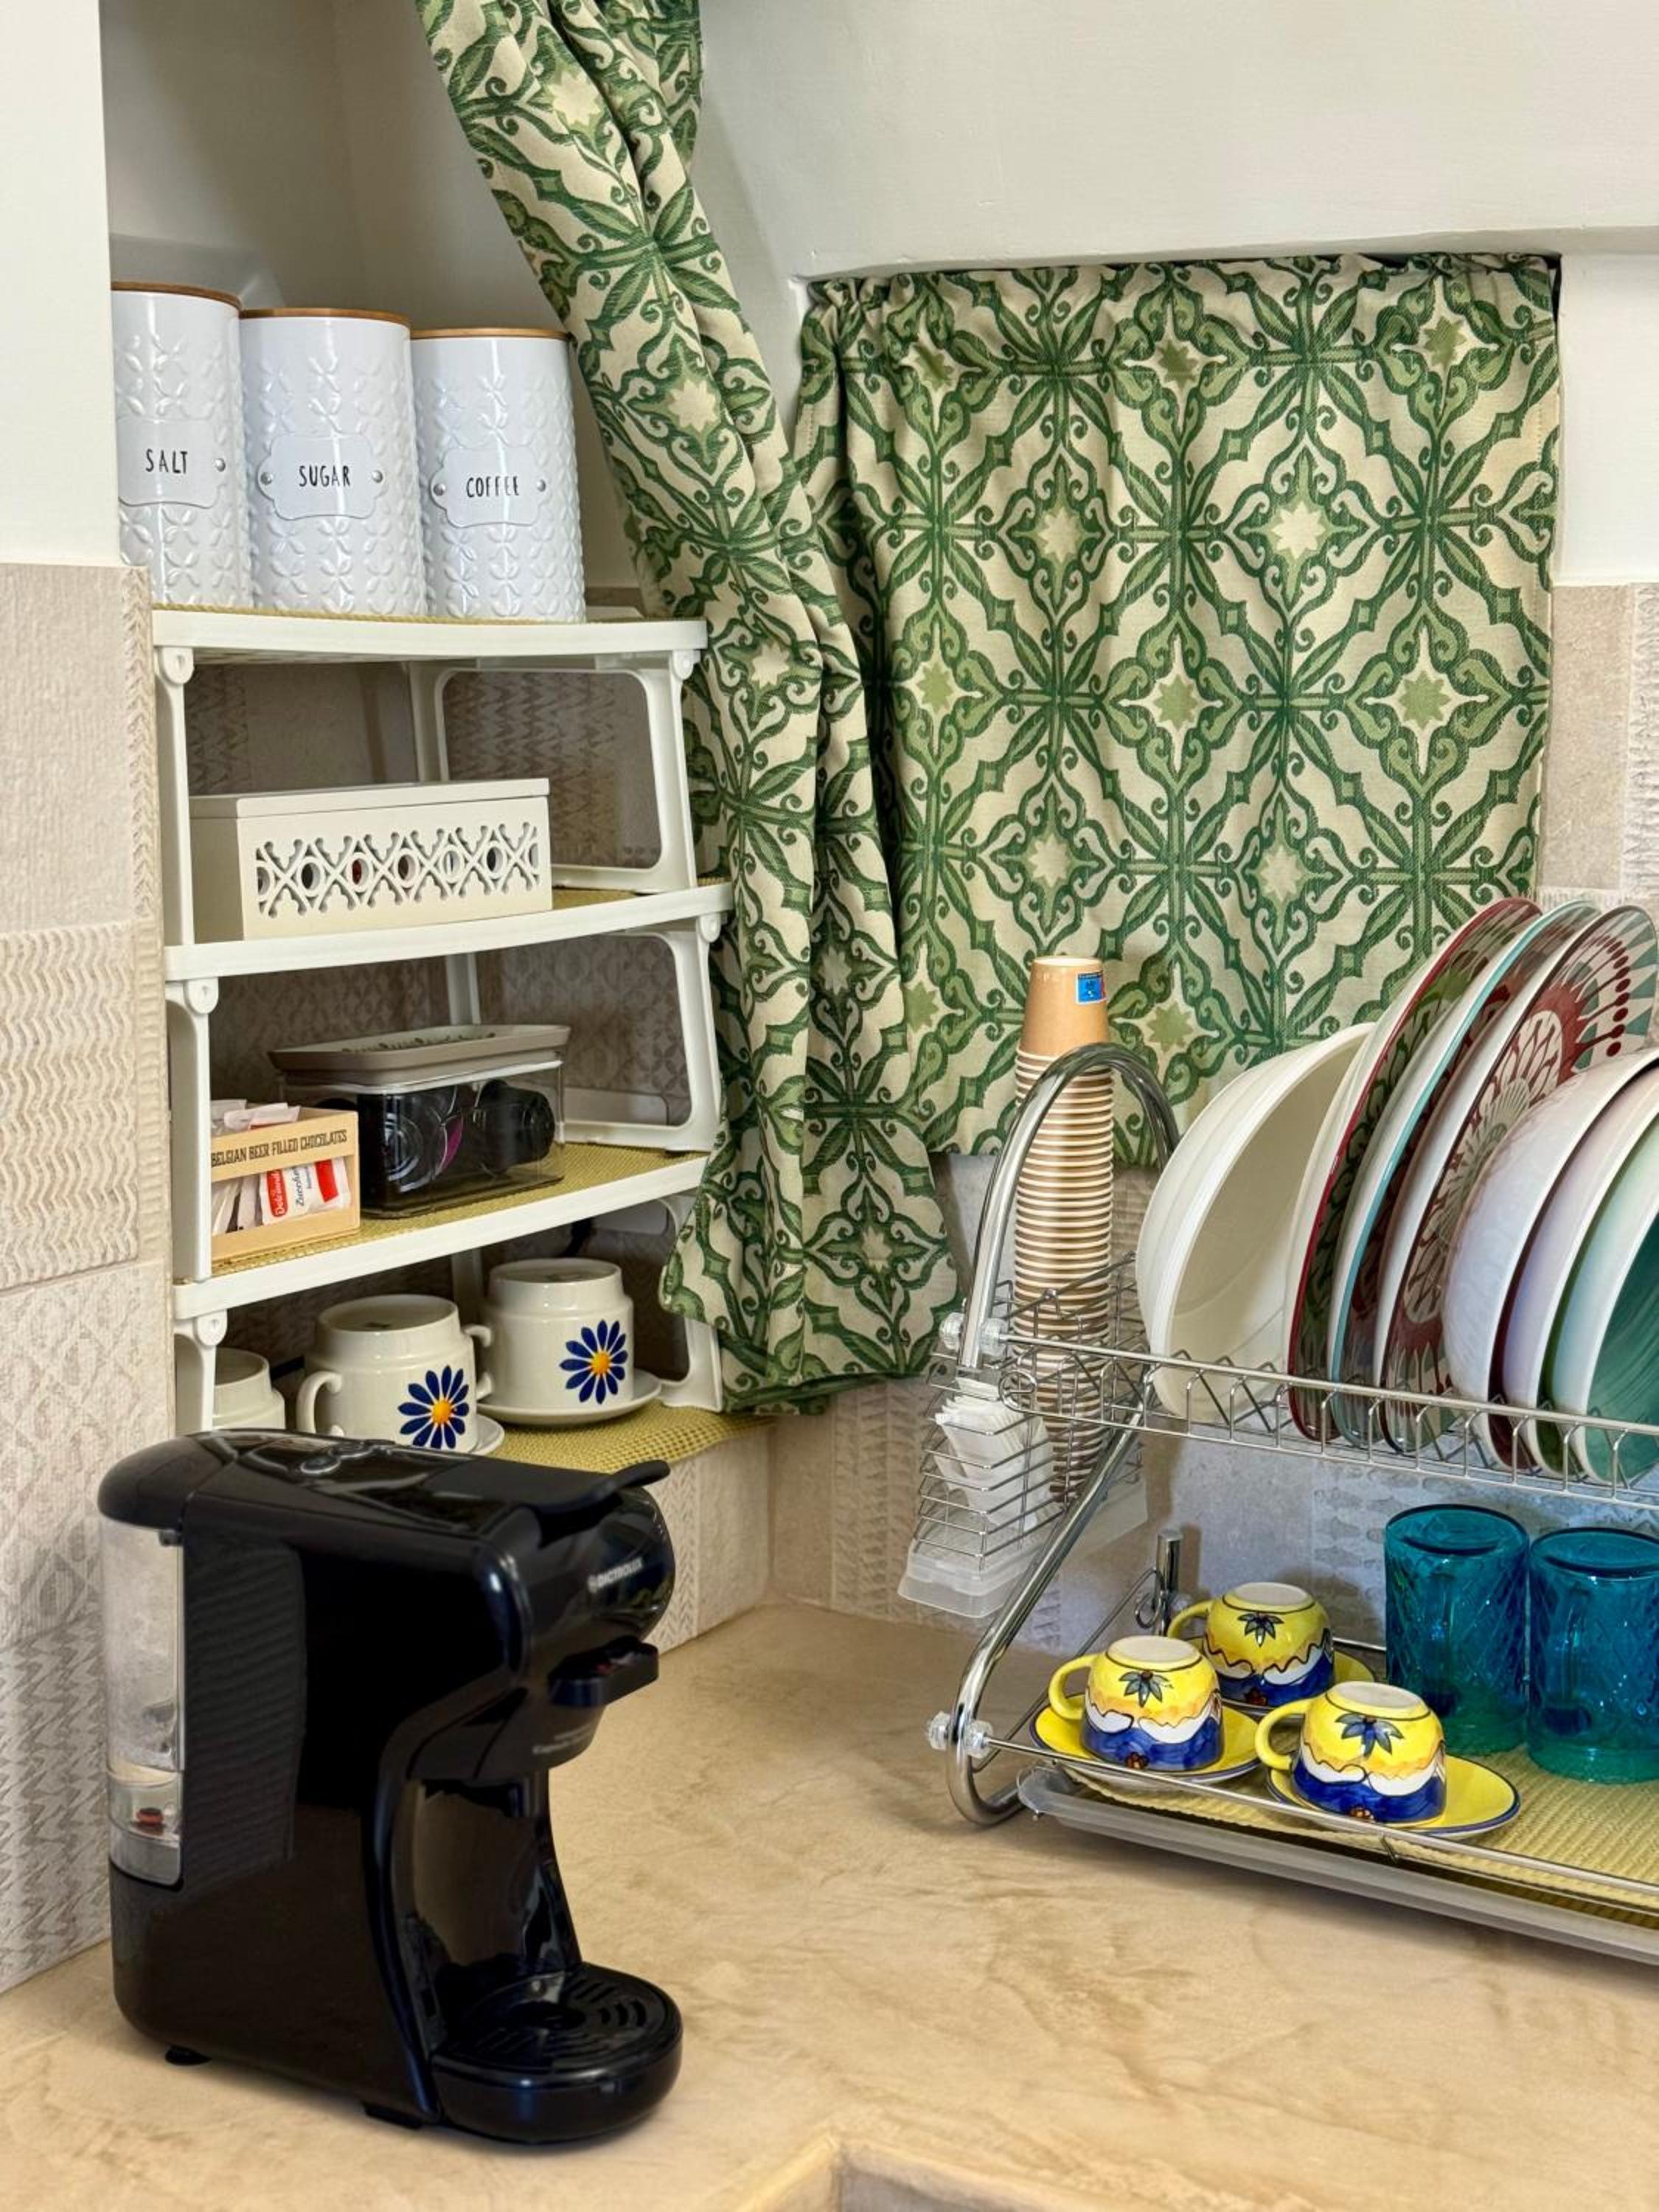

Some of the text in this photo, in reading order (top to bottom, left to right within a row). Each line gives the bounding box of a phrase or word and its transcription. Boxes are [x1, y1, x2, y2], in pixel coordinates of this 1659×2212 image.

[145, 448, 188, 475] SALT
[299, 465, 351, 487] SUGAR
[466, 476, 519, 498] COFFEE
[211, 1129, 348, 1167] BELGIAN BEER FILLED CHOCOLATES
[271, 1169, 285, 1216] Dolciand
